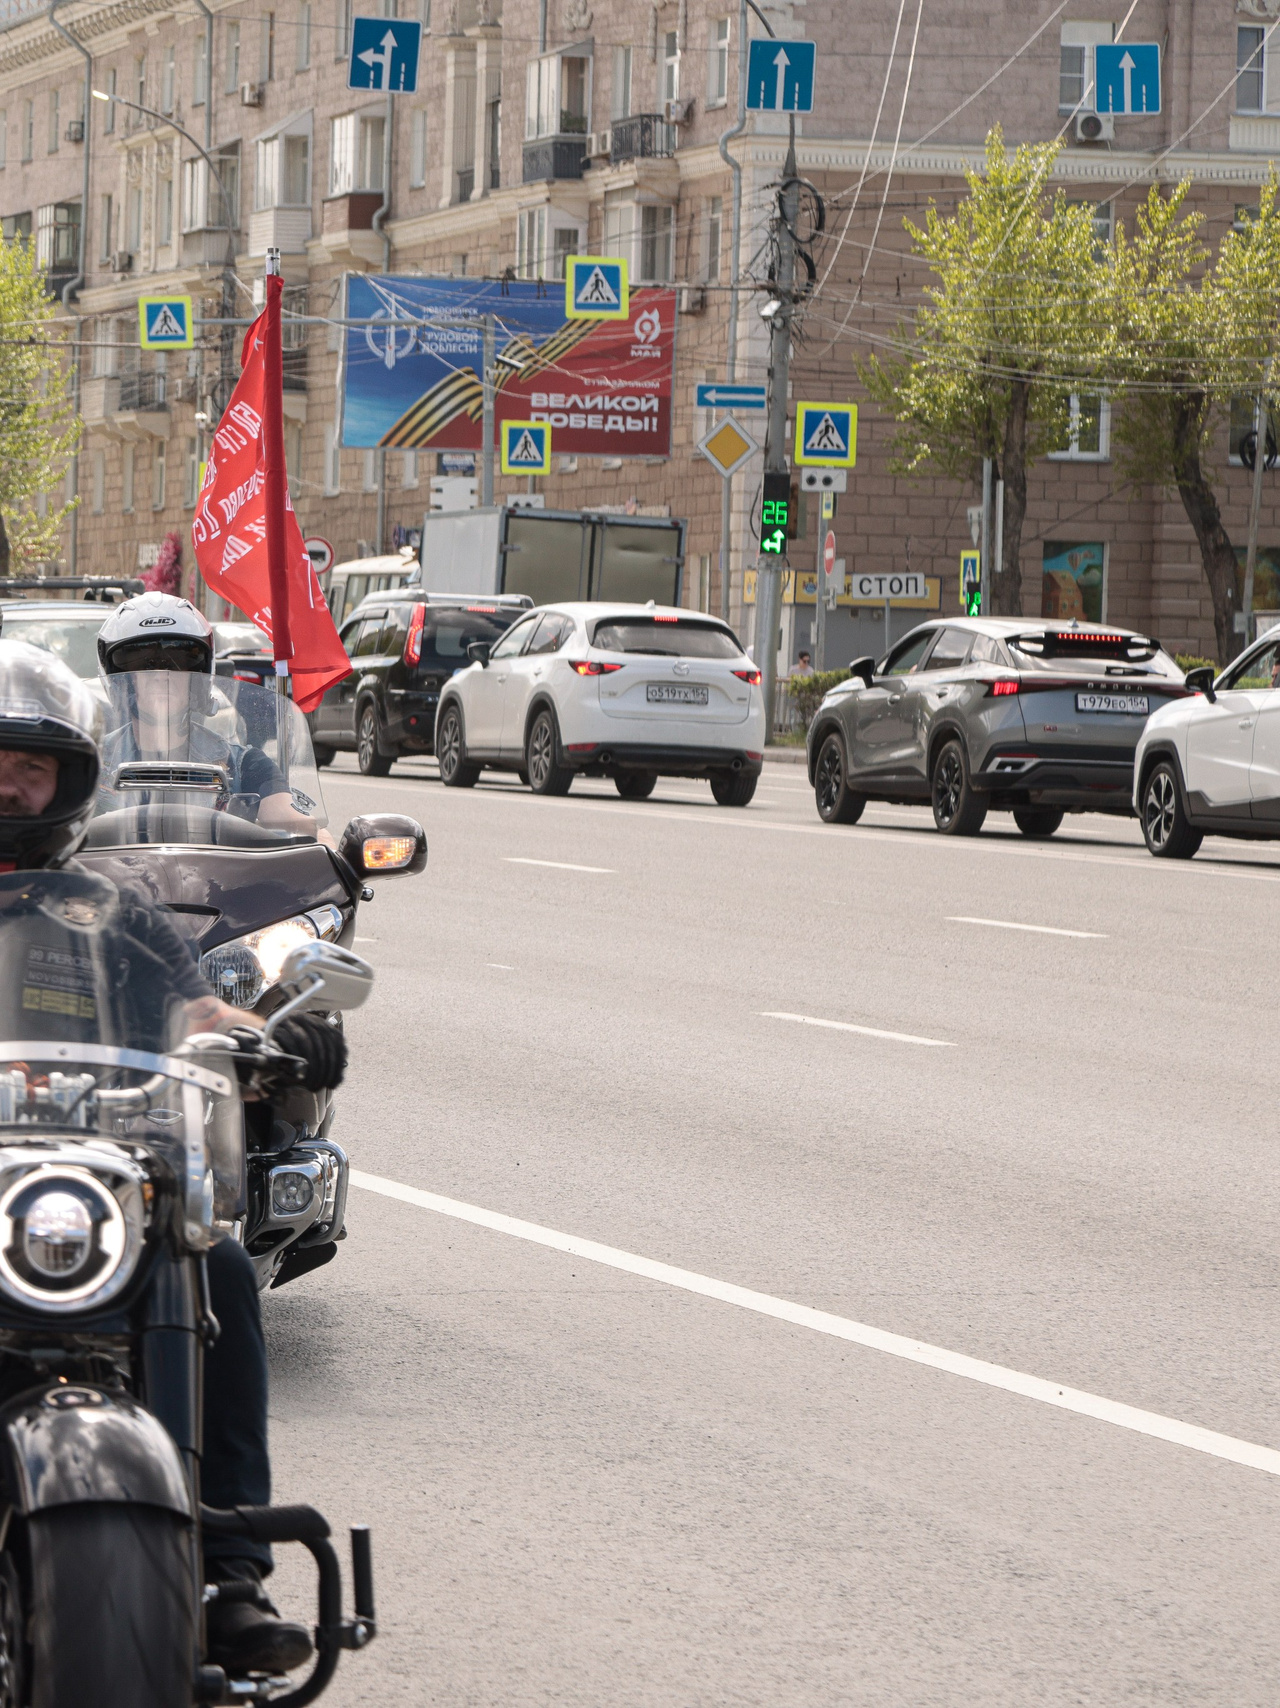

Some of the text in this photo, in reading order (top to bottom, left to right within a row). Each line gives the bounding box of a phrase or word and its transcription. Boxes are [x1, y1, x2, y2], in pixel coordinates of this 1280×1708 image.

[531, 392, 659, 412] ВЕЛИКОЙ
[530, 412, 658, 433] ПОБЕДЫ!
[763, 501, 788, 525] 26
[859, 576, 919, 596] СТОП
[144, 617, 171, 625] HJC
